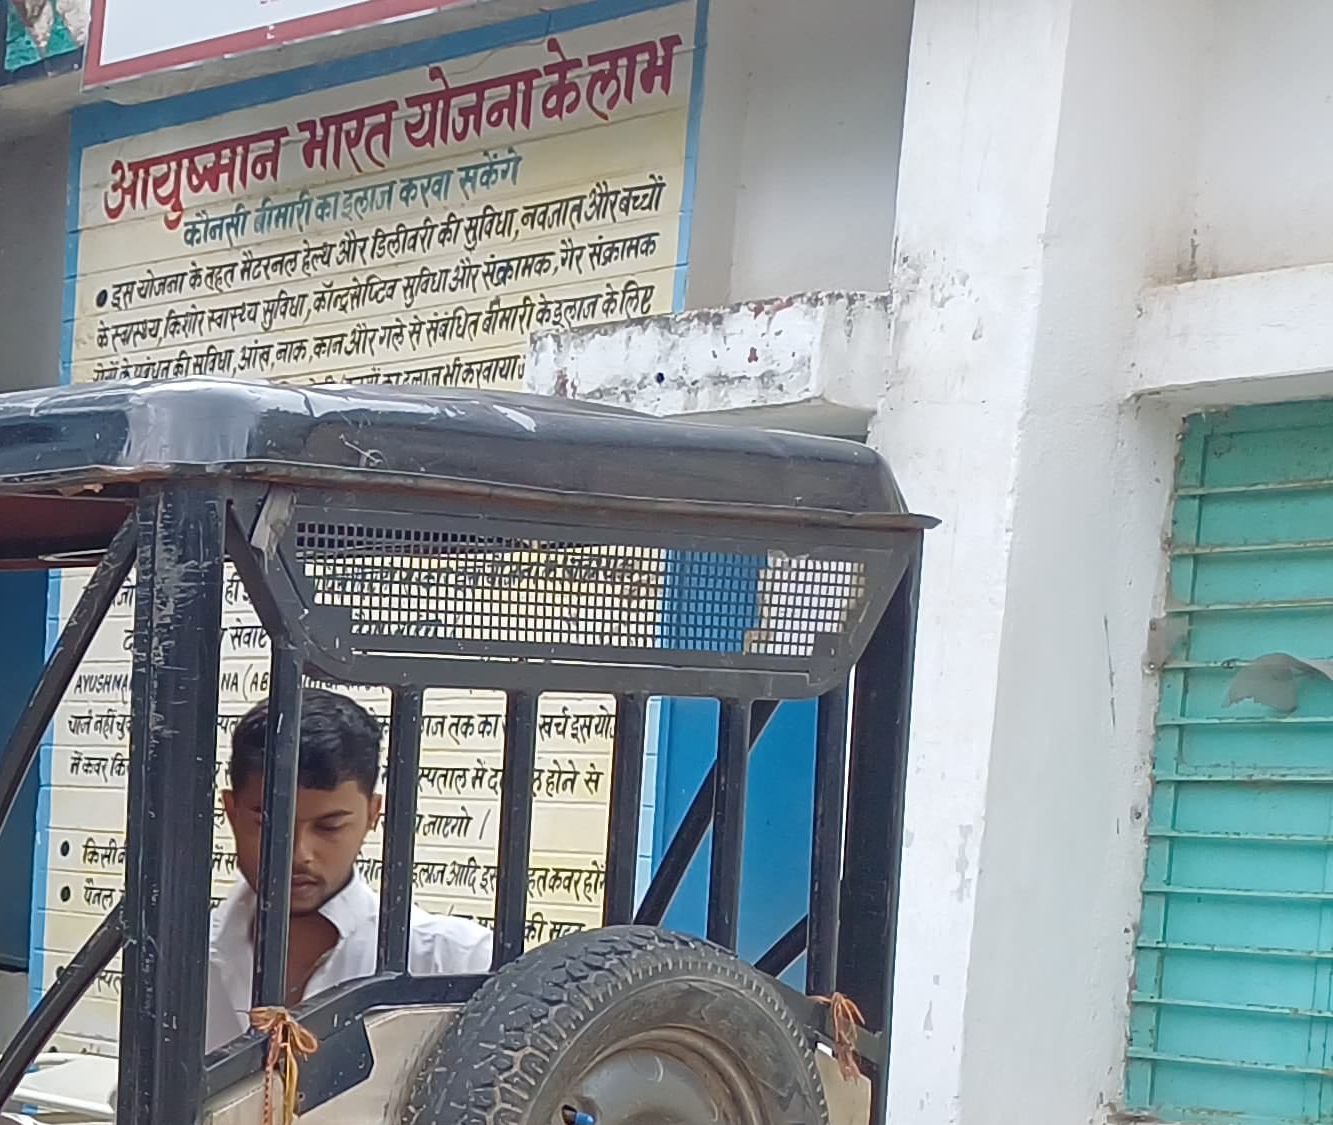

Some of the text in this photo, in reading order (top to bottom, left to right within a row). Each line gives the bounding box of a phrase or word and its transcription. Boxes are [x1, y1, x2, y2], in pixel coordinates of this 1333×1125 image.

[103, 34, 683, 230] आयुष्मान भारत योजना के लाभ
[183, 146, 523, 248] कौनसी बीमारी का इलाज करवा सकेंगे
[112, 281, 135, 311] इस
[137, 269, 185, 299] योजना
[240, 250, 301, 281] मैटरनल
[336, 228, 368, 265] और
[371, 216, 436, 258] डिलीवरी
[437, 212, 463, 248] की
[521, 194, 587, 231] नवजात
[584, 180, 619, 221] और
[619, 174, 666, 215] बच्चों
[96, 319, 110, 349] के
[164, 304, 206, 339] किशोर
[402, 266, 451, 308] सुविधा
[449, 256, 483, 294] और
[560, 238, 585, 275] गैर
[587, 231, 661, 271] संक्रामक
[313, 333, 347, 360] कान
[344, 322, 379, 358] और
[379, 317, 407, 352] गले
[408, 314, 425, 352] से
[426, 306, 483, 348] संबंधित
[482, 295, 537, 336] बीमारी
[552, 293, 604, 330] इलाज
[601, 282, 619, 314] के
[619, 280, 655, 316] लिए
[74, 670, 132, 704] AYUSHMA
[448, 714, 475, 745] तक
[477, 713, 502, 738] का
[571, 714, 595, 744] इस
[419, 766, 470, 795] स्पताल
[546, 759, 580, 798] होने
[584, 763, 604, 795] से
[446, 856, 481, 895] आदि
